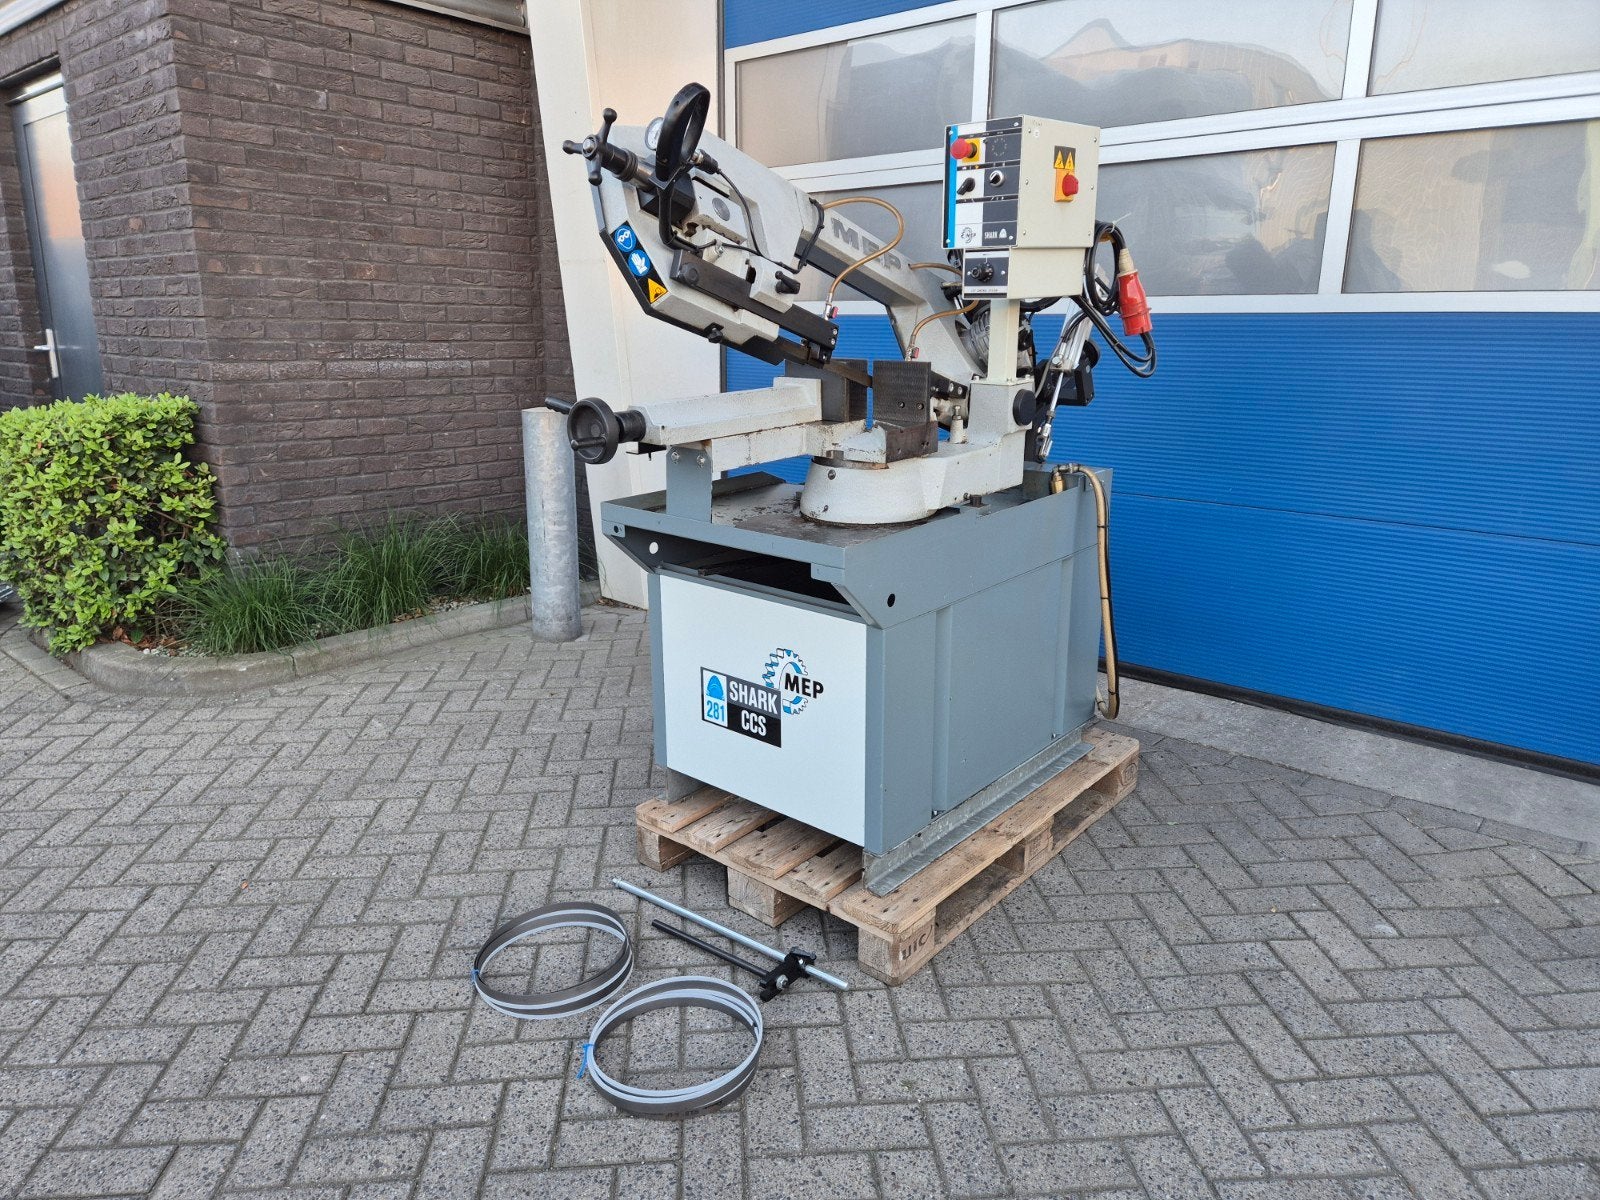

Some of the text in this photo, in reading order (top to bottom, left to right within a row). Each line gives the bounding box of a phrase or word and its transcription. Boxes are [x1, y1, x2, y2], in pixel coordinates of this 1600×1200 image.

[729, 680, 778, 715] SHARK
[784, 672, 824, 699] MEP
[706, 699, 725, 722] 281
[741, 709, 767, 736] CCS
